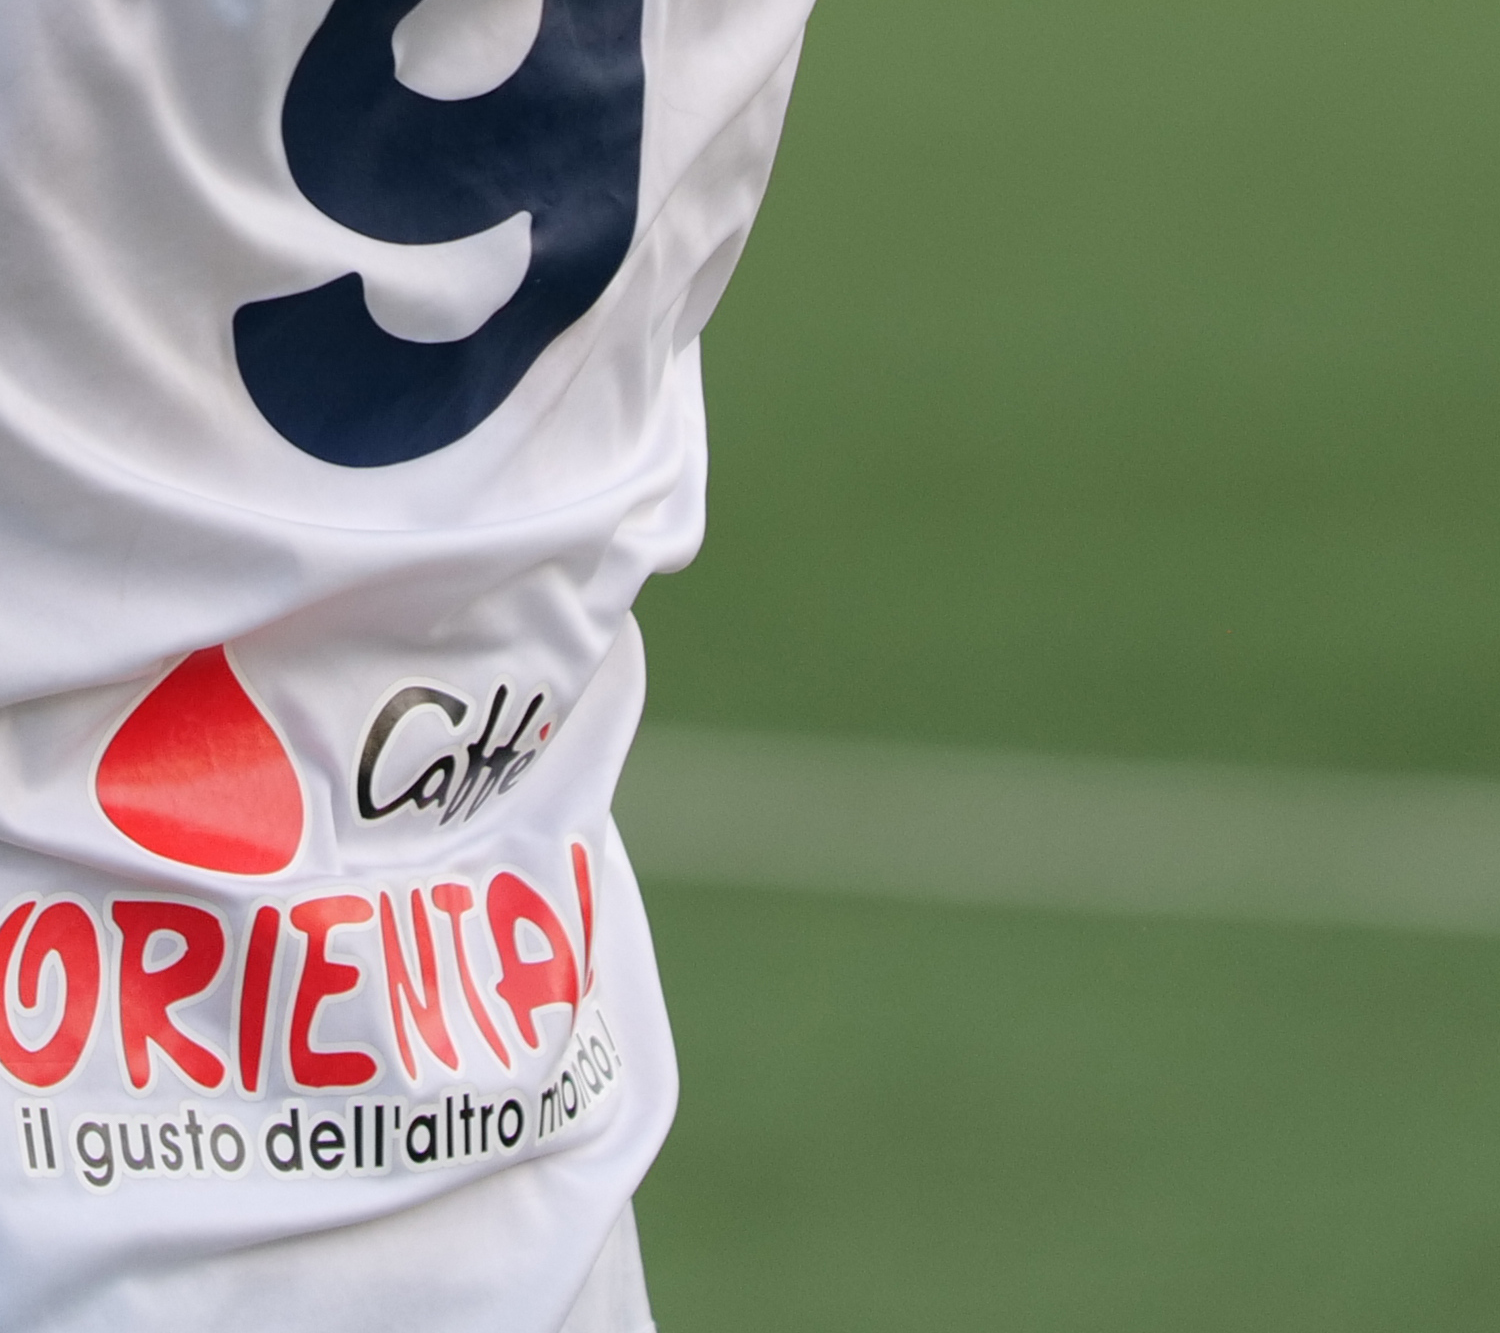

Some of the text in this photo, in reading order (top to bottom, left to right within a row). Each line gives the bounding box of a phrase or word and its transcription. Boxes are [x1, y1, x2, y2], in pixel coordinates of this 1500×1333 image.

[21, 1107, 56, 1169] il
[76, 1109, 246, 1187] gusto
[265, 1093, 525, 1173] dell'altro
